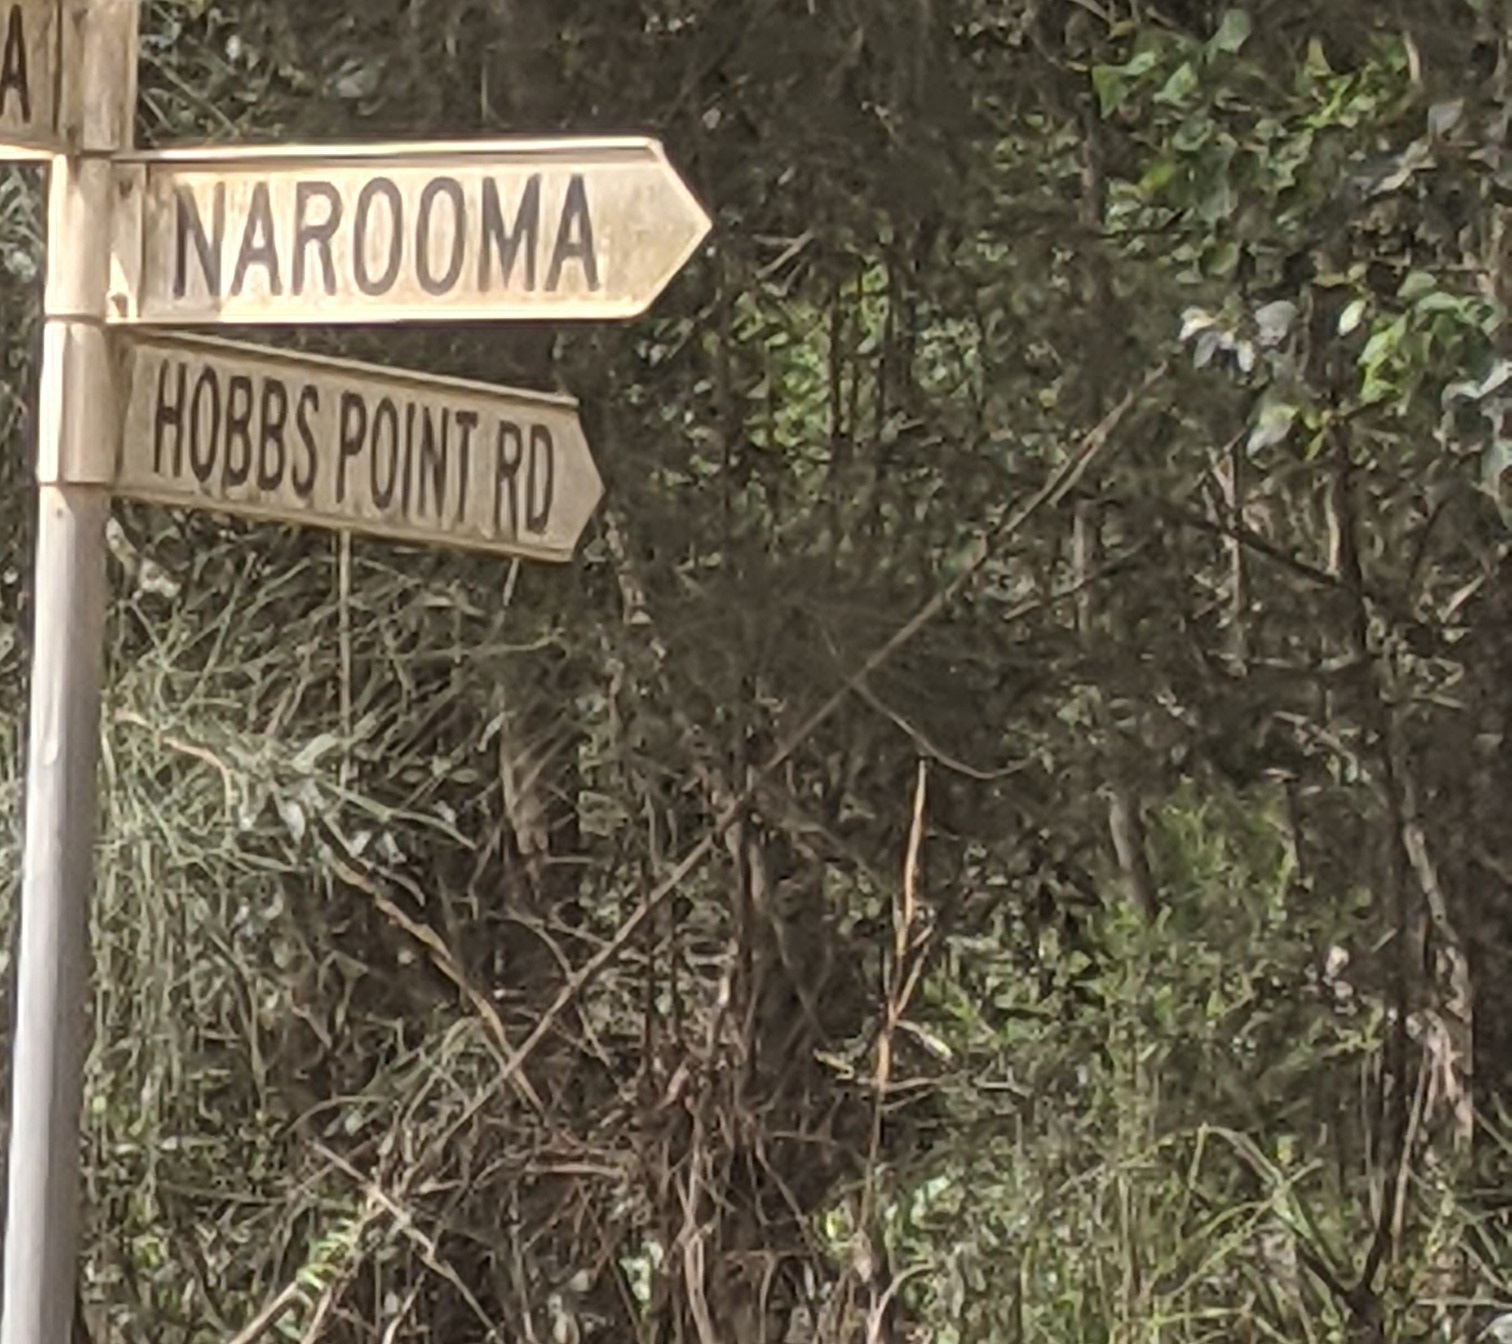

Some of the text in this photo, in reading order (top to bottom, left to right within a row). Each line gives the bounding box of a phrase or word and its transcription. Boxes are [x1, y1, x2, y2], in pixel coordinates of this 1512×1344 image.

[173, 173, 601, 298] NAROOMA
[153, 359, 555, 536] HOBBS POINT RD
